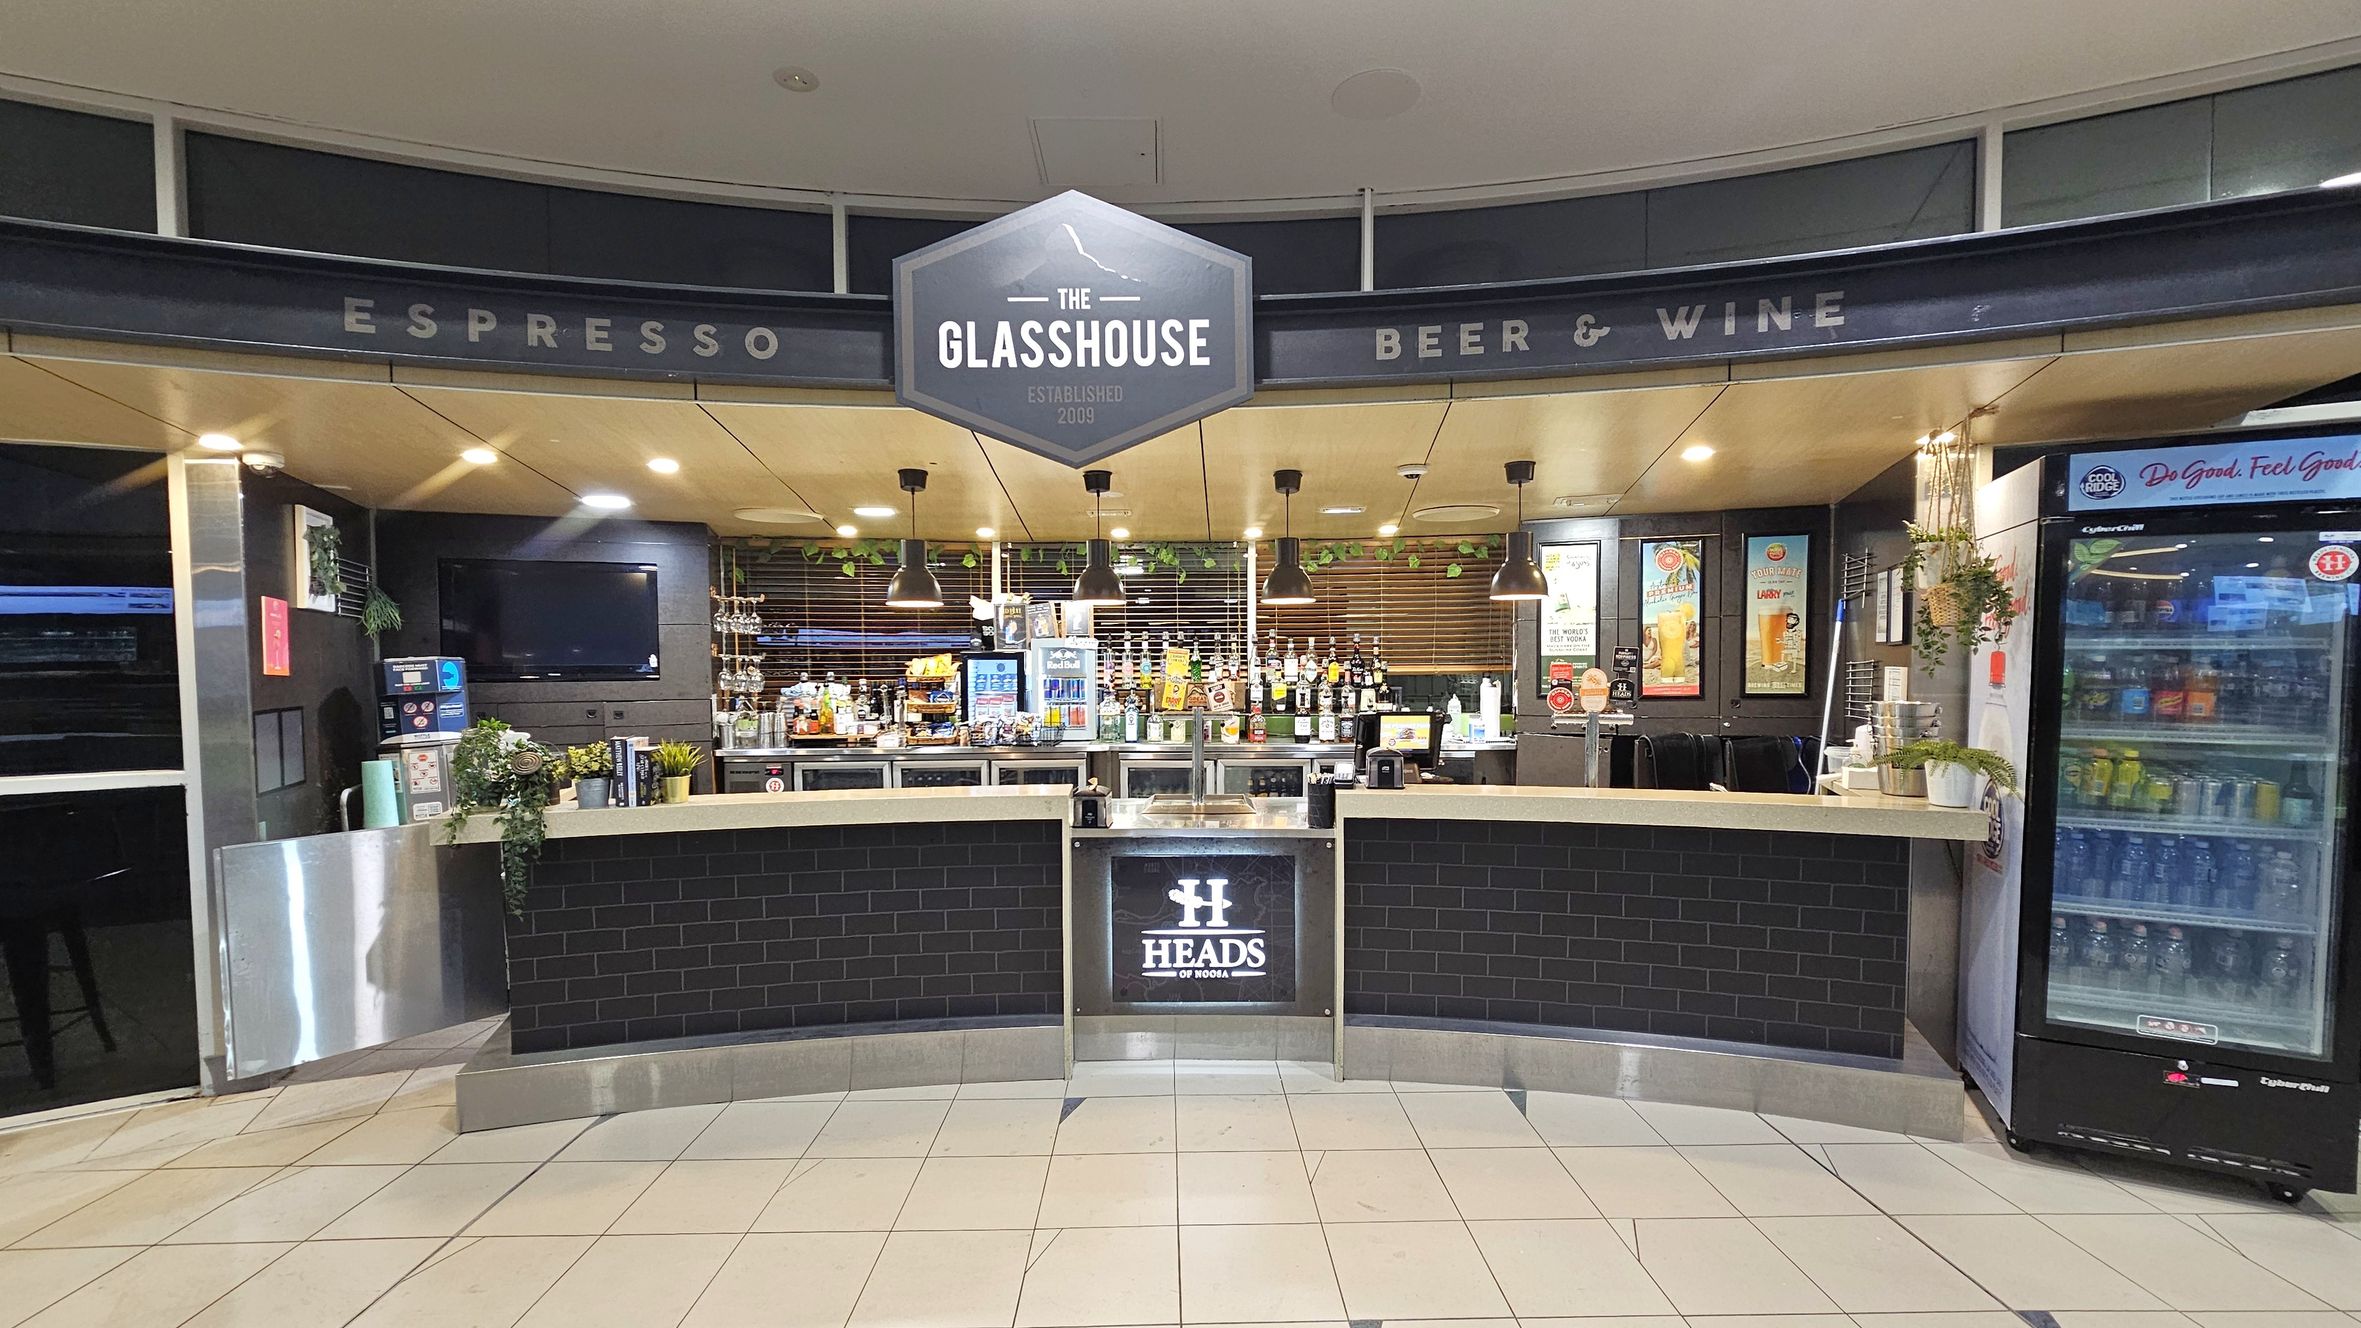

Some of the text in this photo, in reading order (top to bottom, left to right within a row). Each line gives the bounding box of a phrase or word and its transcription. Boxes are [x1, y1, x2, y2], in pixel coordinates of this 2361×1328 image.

[1057, 288, 1091, 310] THE
[343, 296, 779, 360] ESPRESSO
[1375, 290, 1845, 361] BEER & WINE
[938, 318, 1211, 369] GLASSHOUSE
[1028, 386, 1123, 403] ESTABLISHED
[1057, 406, 1095, 424] 2009
[2088, 473, 2118, 482] COOL
[2139, 462, 2178, 487] Do
[2181, 458, 2242, 490] Good.
[2249, 456, 2296, 479] Feel
[2085, 481, 2120, 492] RIDGE
[2081, 523, 2144, 534] CyberChill
[1751, 567, 1802, 579] YOUR MATE
[1648, 584, 1693, 597] PREMIUM
[1757, 589, 1781, 599] LARRY
[1046, 660, 1080, 669] Red Bull
[1141, 938, 1267, 969] HEADS
[1179, 969, 1229, 979] OF NOOSA
